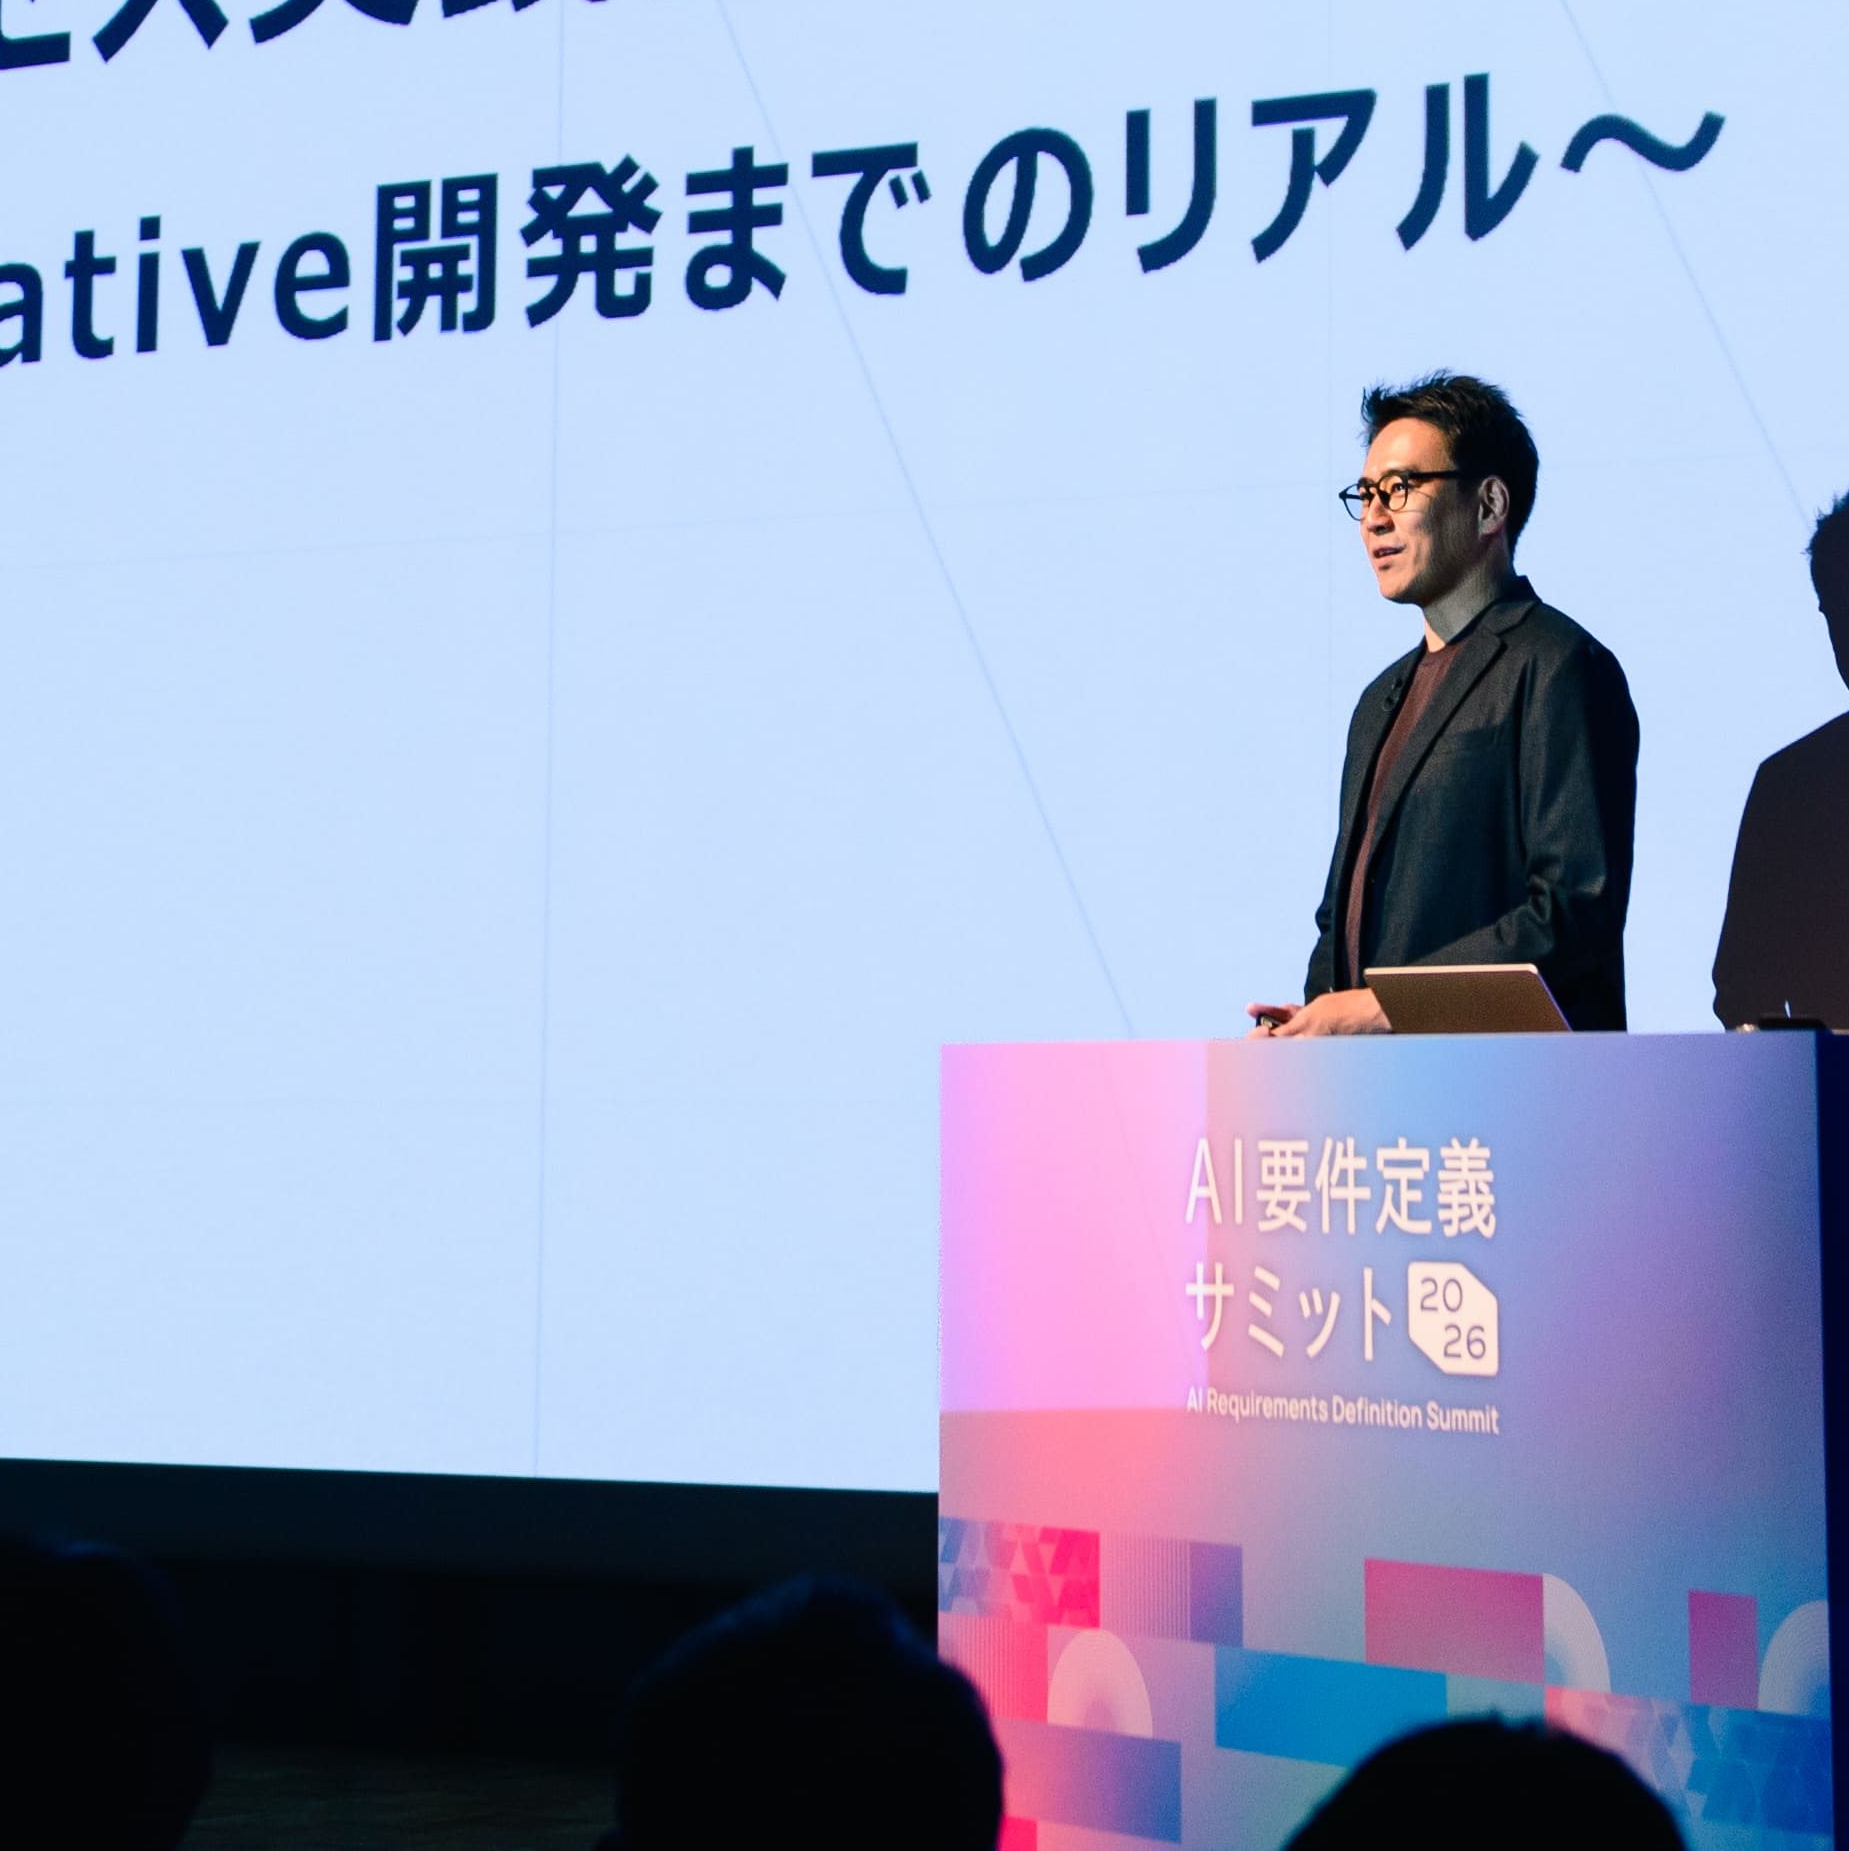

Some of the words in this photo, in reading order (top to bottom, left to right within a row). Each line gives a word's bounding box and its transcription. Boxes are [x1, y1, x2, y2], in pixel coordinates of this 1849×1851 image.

[1185, 1136, 1497, 1239] AI要件定義
[1184, 1261, 1392, 1362] サミット
[1419, 1277, 1465, 1312] 20
[1442, 1324, 1487, 1360] 26
[1186, 1386, 1203, 1413] AI
[1207, 1387, 1329, 1424] Requirements
[1332, 1394, 1423, 1429] Definition
[1426, 1400, 1500, 1435] Summit
